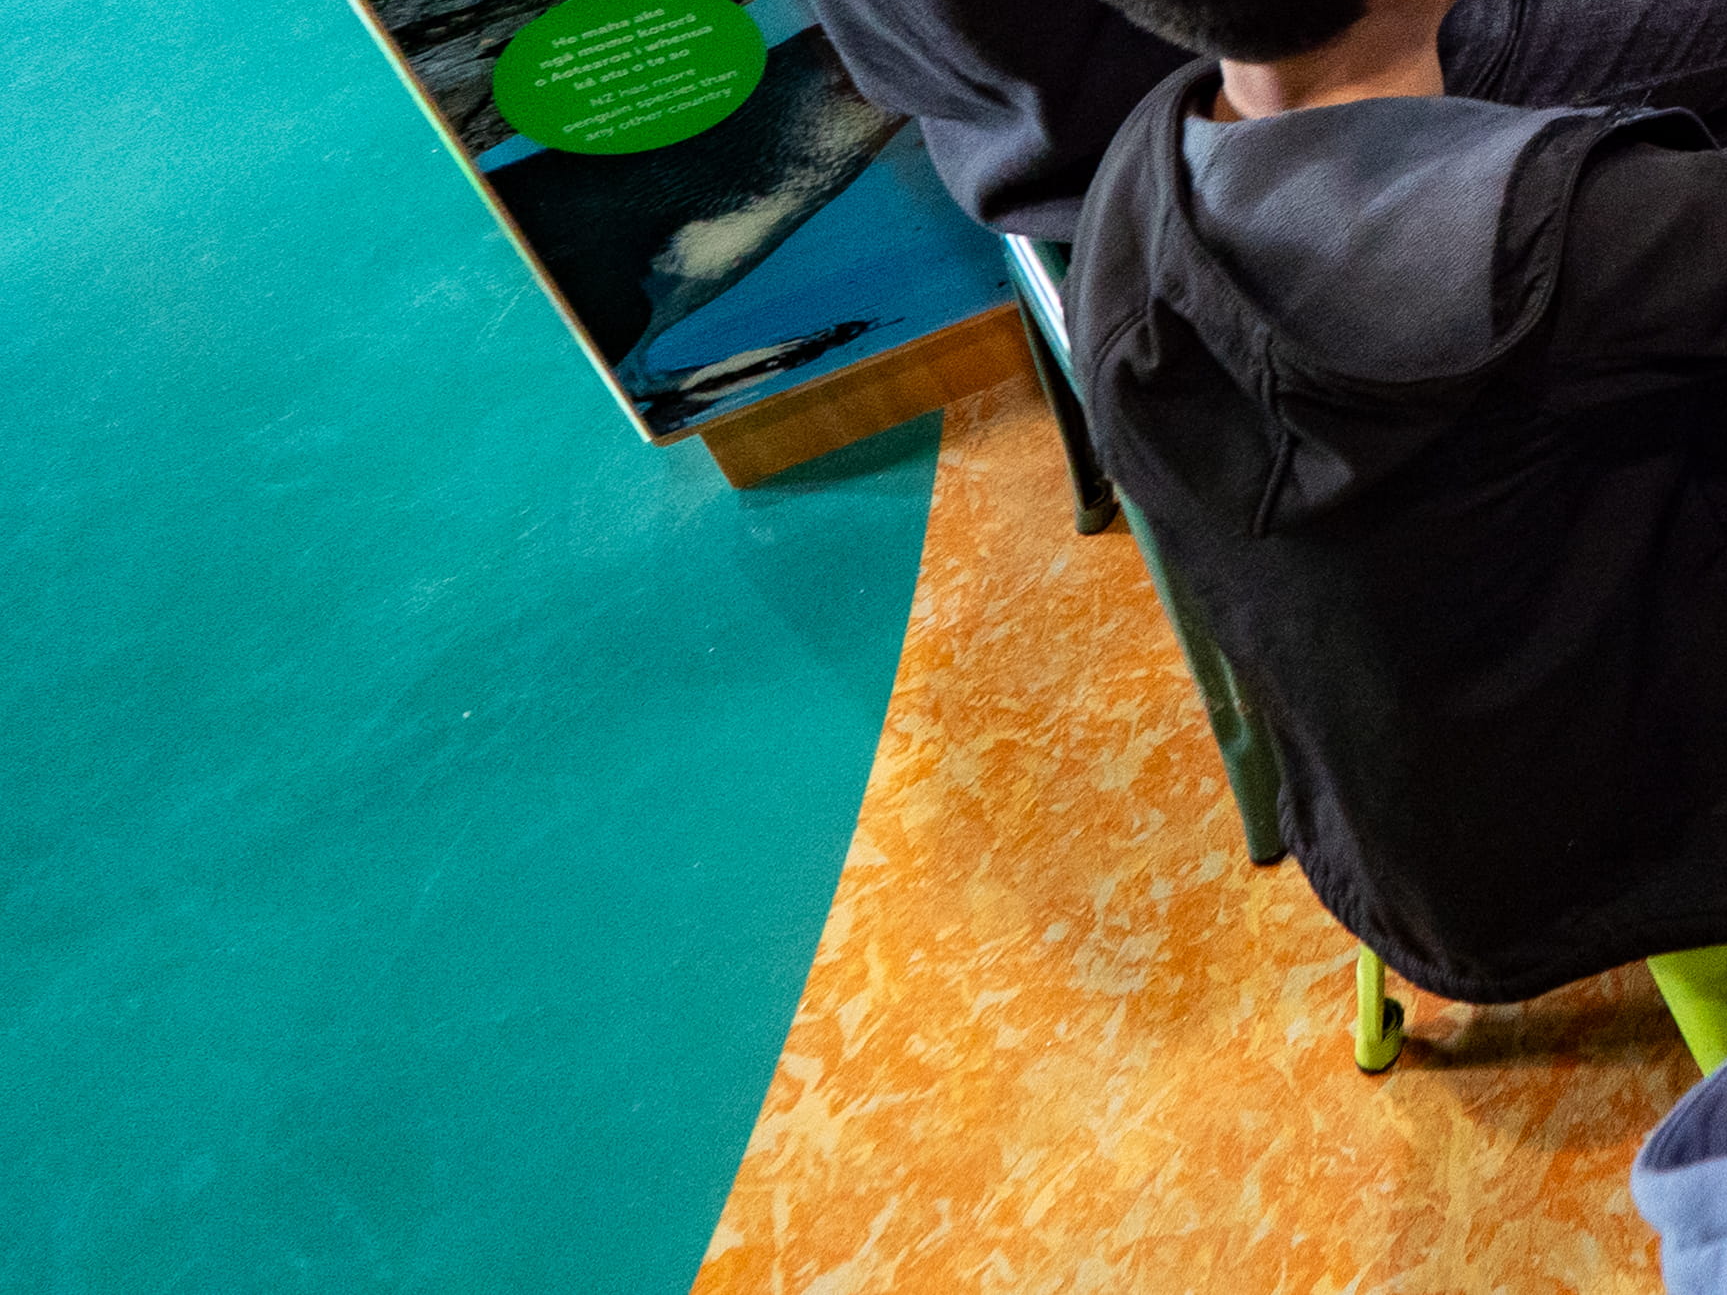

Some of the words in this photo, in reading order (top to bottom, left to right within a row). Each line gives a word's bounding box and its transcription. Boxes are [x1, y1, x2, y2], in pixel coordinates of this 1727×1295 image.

[578, 35, 634, 57] momo
[551, 51, 632, 82] Aotearoa
[562, 105, 633, 134] penguin
[636, 84, 697, 109] species
[699, 70, 739, 87] than
[589, 93, 616, 107] NZ
[618, 84, 649, 97] has
[652, 69, 696, 87] more
[585, 127, 615, 142] any
[619, 111, 663, 130] other
[668, 88, 732, 113] country
